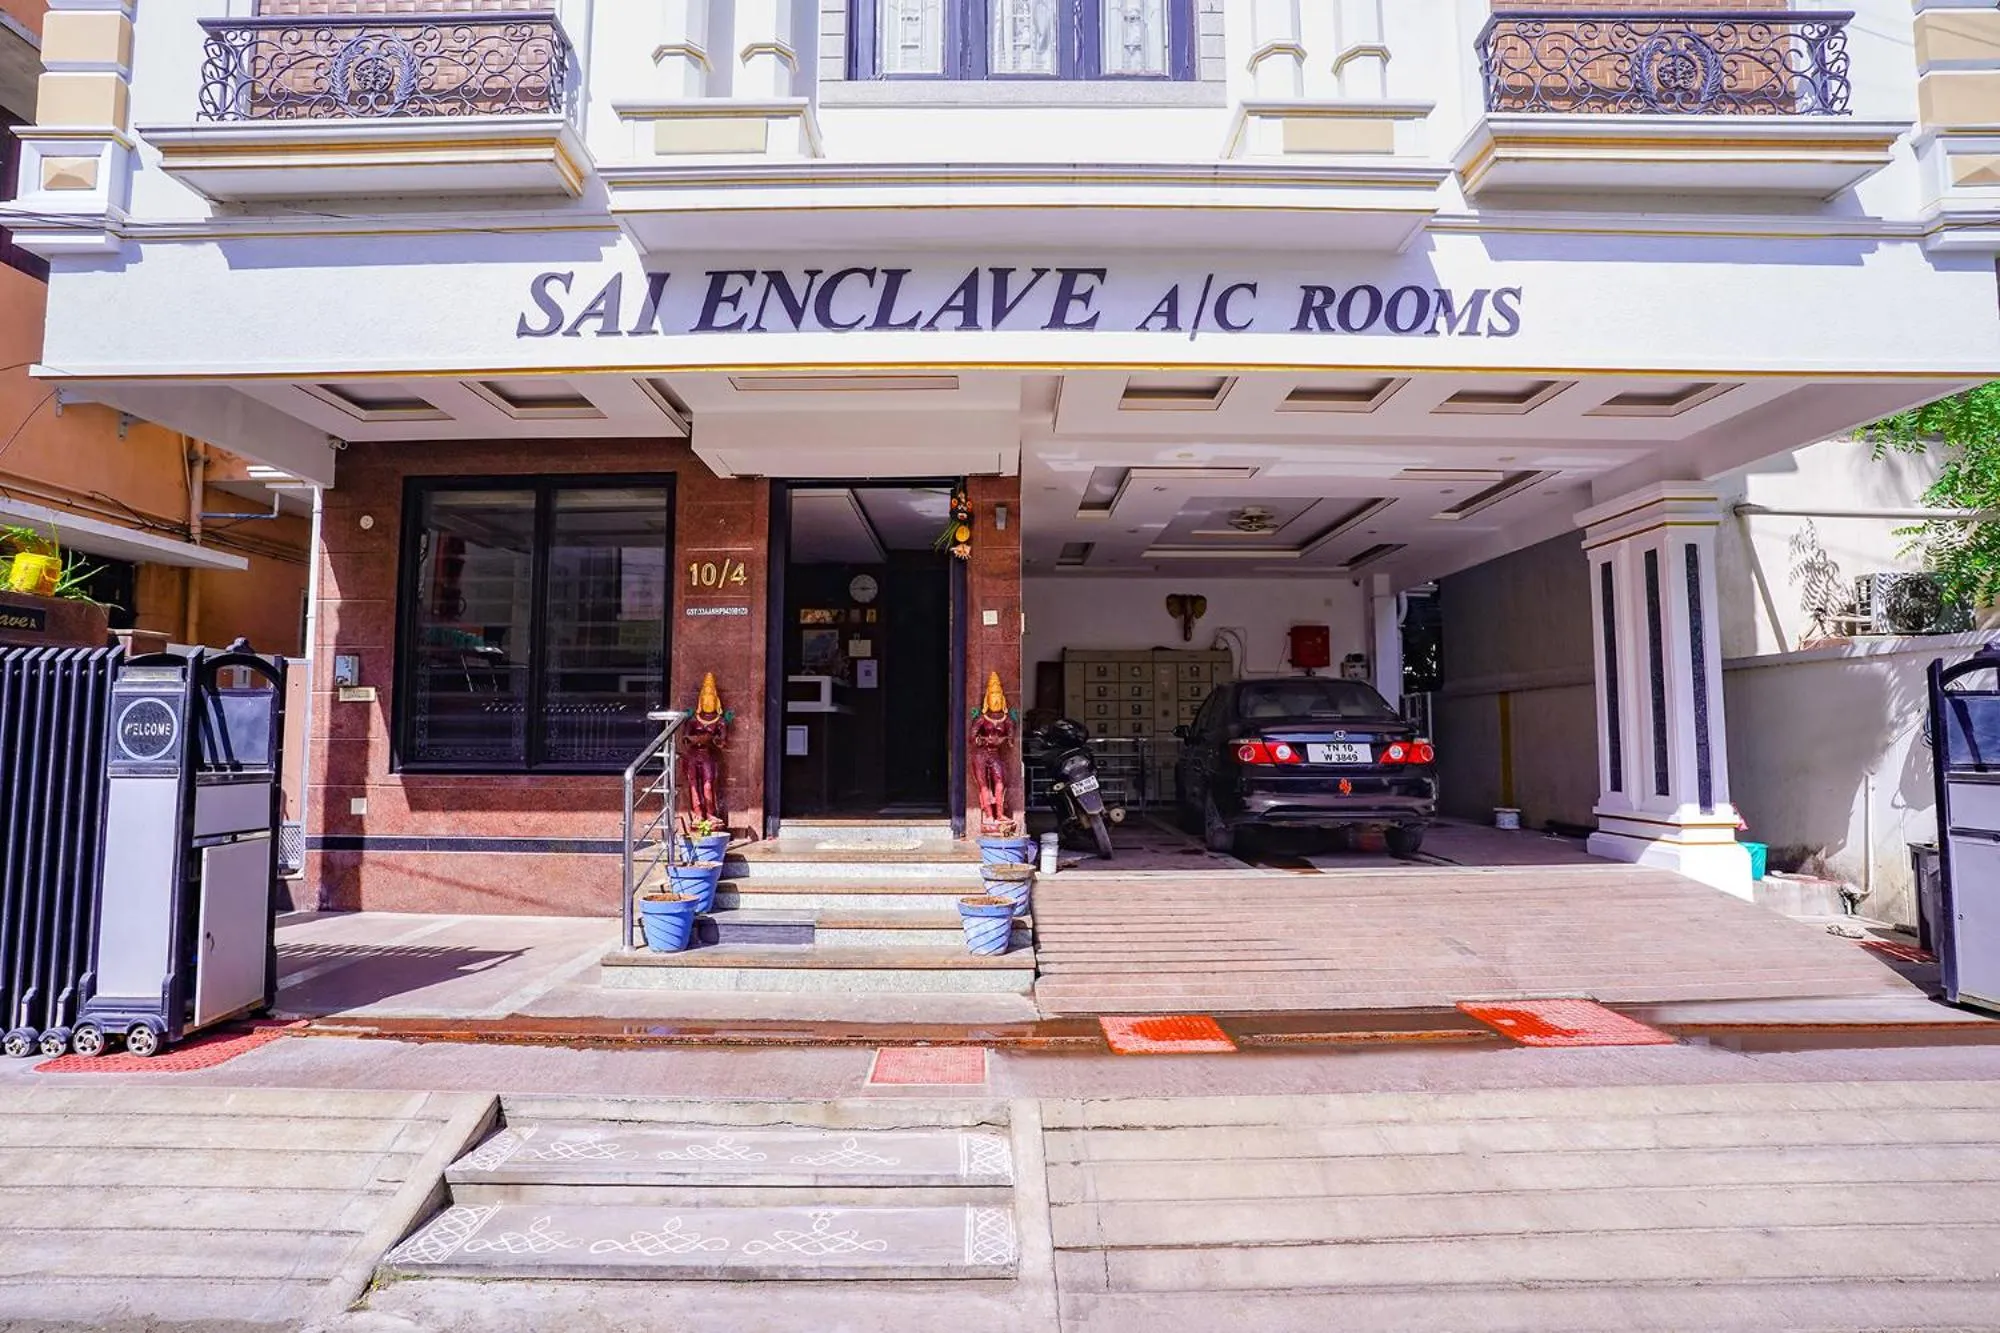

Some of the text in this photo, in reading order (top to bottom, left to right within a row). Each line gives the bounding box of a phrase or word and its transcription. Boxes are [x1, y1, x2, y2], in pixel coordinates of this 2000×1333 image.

[516, 266, 1523, 342] SAI ENCLAVE A/C ROOMS
[689, 558, 748, 589] 10/4
[124, 722, 171, 736] WELCOME
[1325, 744, 1354, 752] TN 10
[1324, 753, 1333, 761] W
